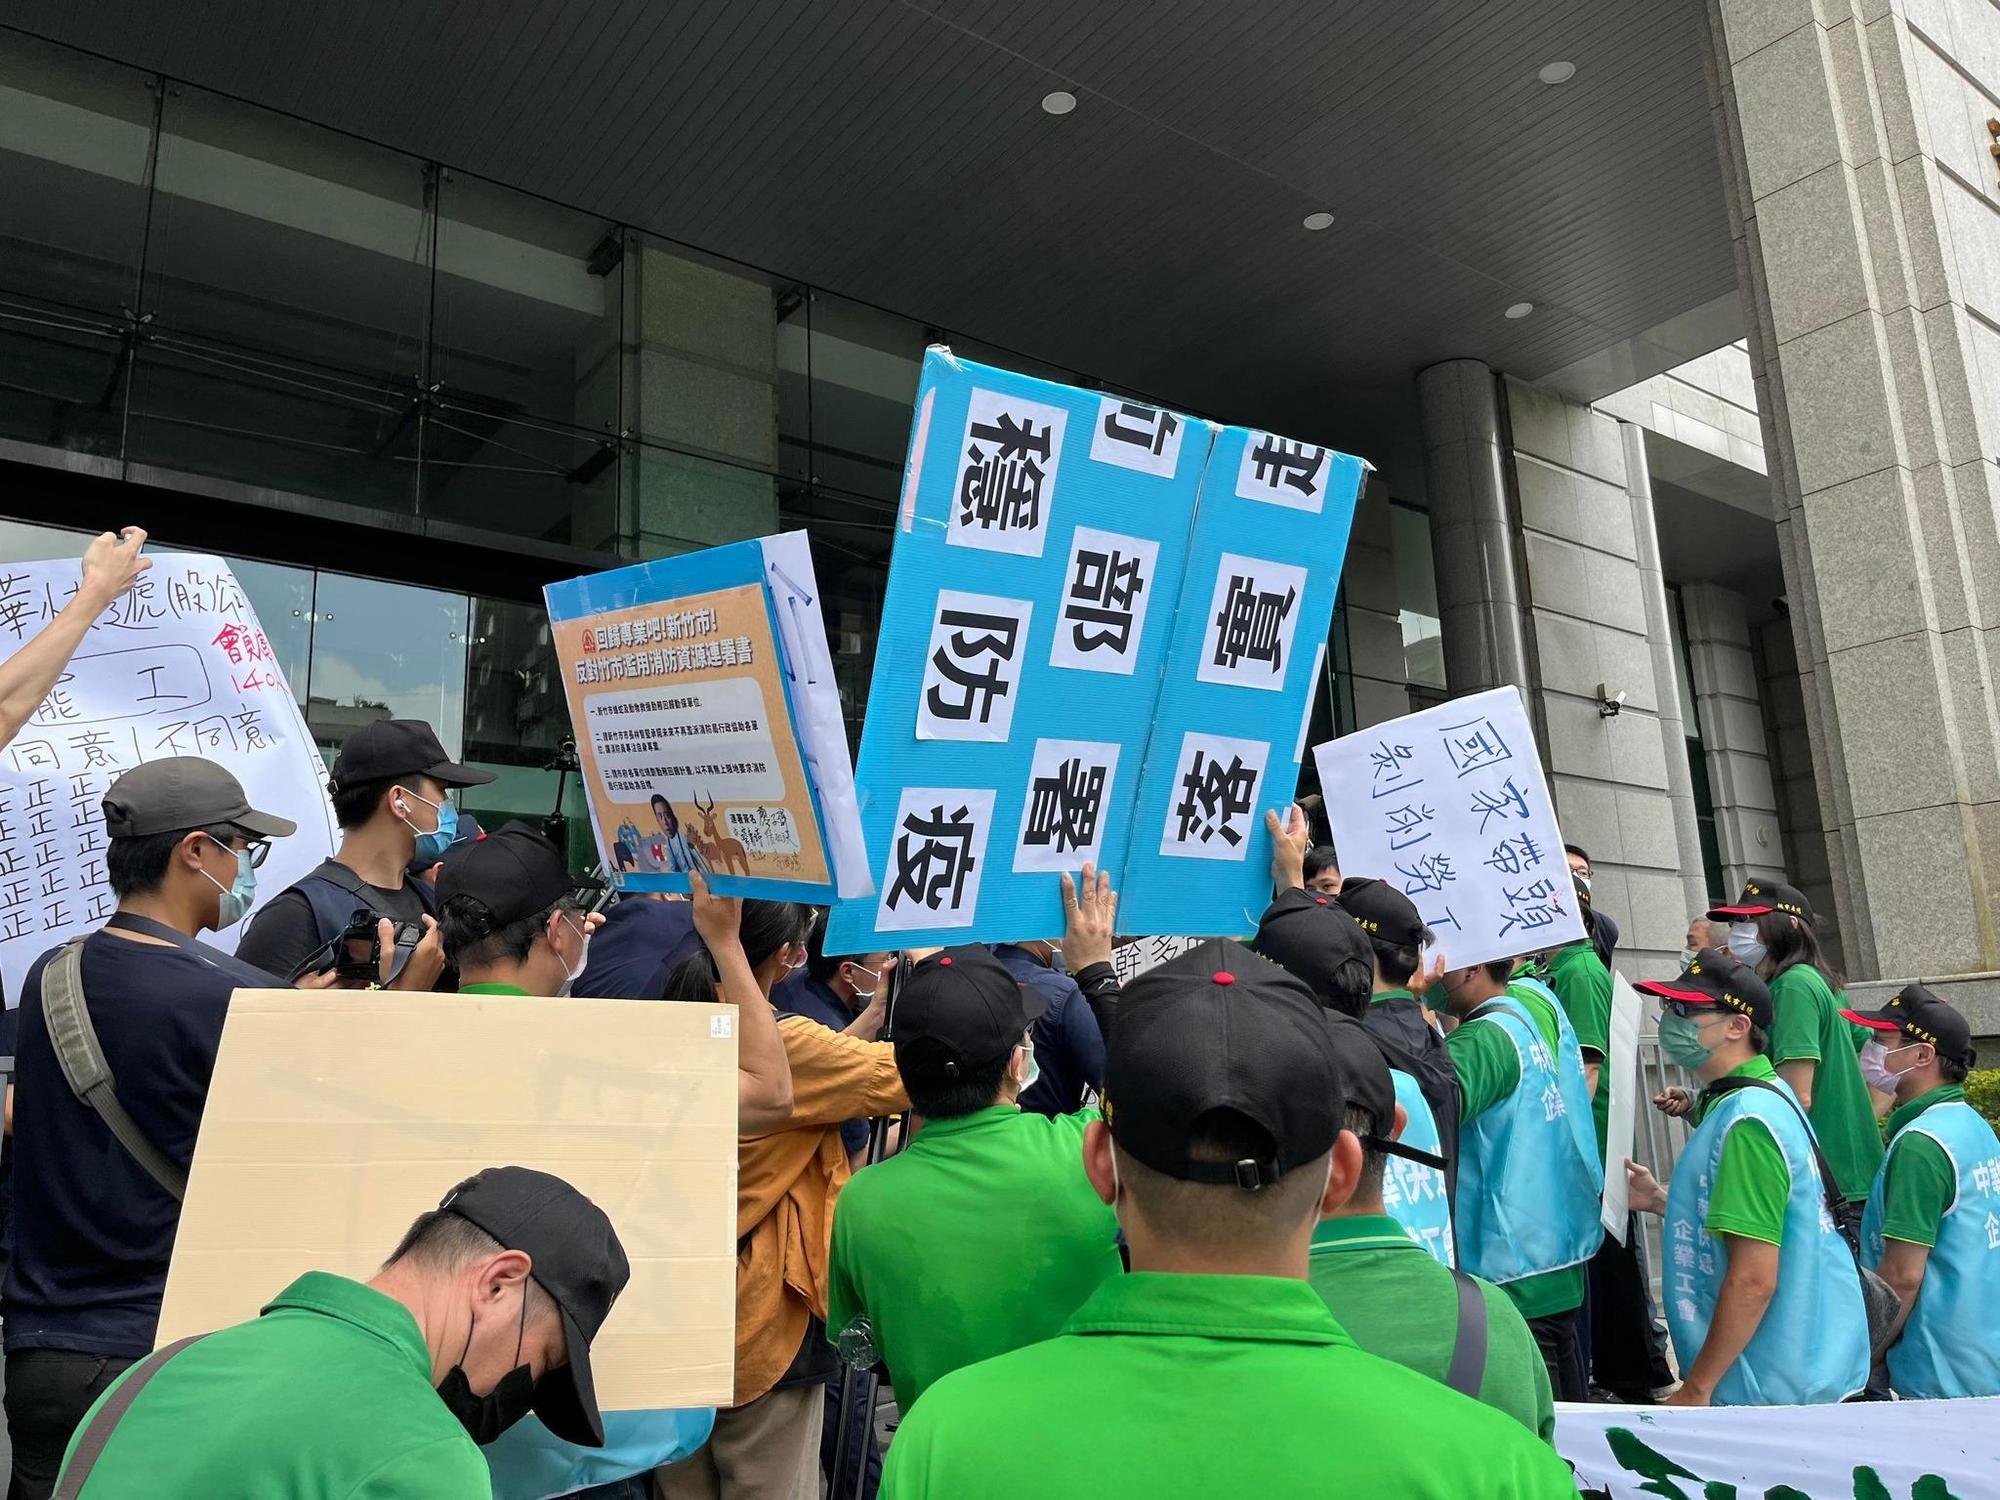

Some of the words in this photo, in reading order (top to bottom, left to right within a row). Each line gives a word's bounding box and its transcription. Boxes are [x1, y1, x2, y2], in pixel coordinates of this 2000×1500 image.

[576, 637, 752, 684] 反對竹市濫用消防資源連署書
[886, 412, 1053, 911] 穩防疫
[11, 731, 119, 771] 同意
[154, 703, 277, 754] 不同意
[1439, 716, 1567, 938] 國家帶頭
[1673, 1218, 1697, 1322] 企業工會
